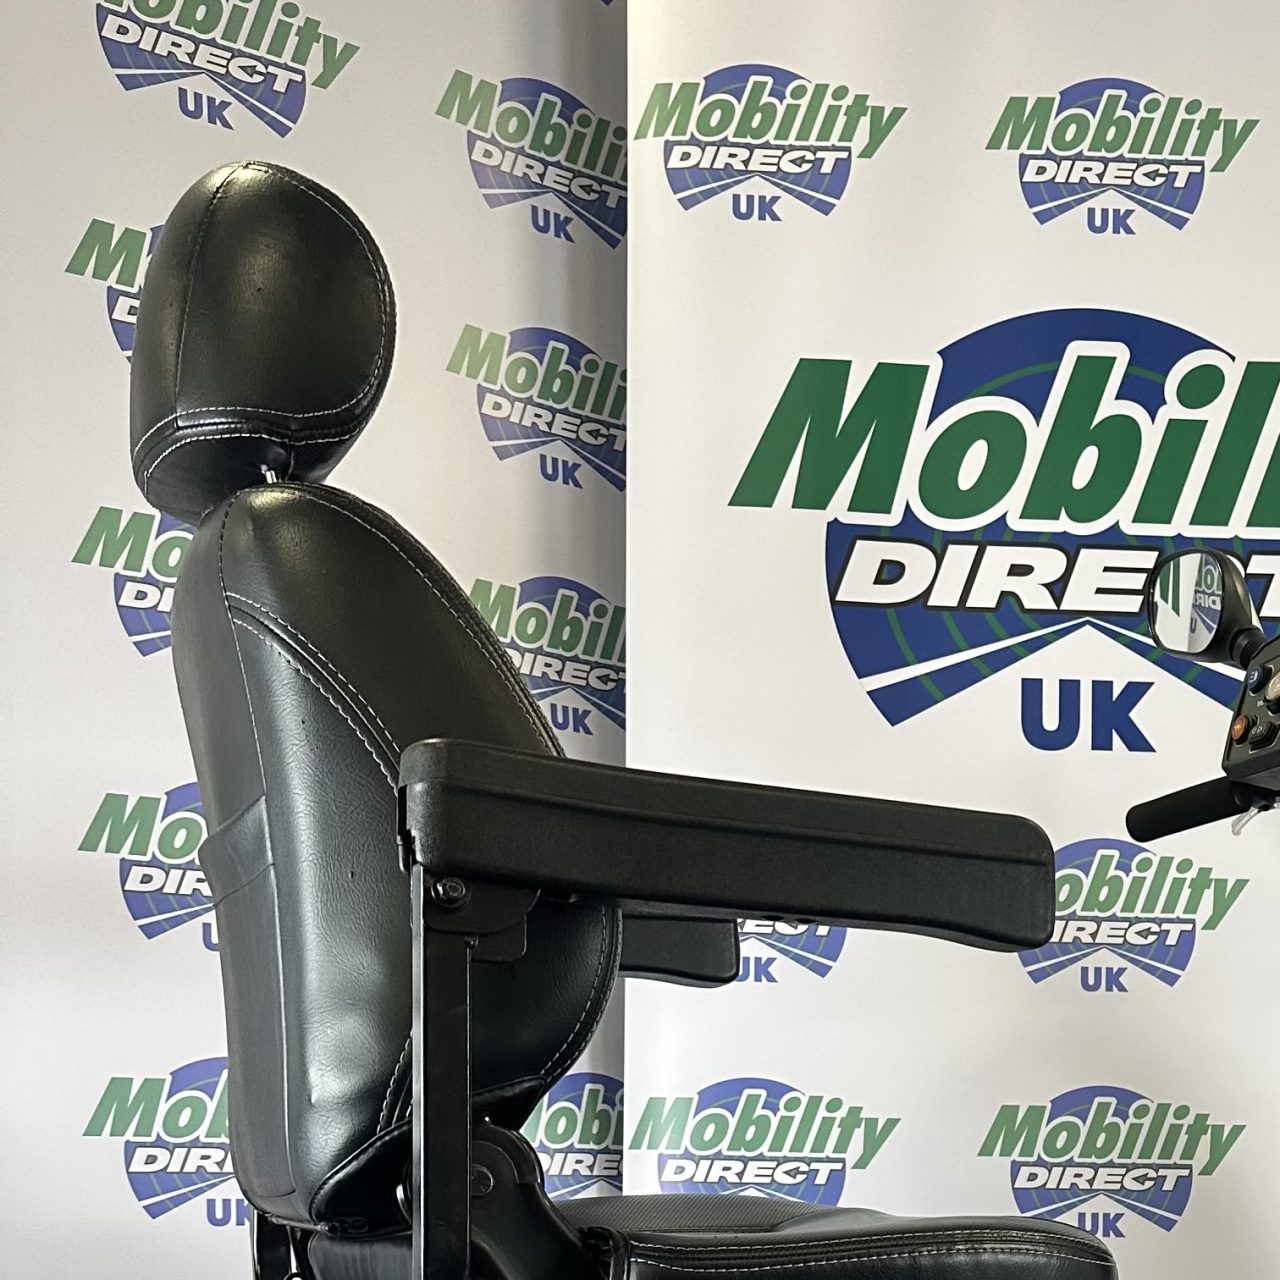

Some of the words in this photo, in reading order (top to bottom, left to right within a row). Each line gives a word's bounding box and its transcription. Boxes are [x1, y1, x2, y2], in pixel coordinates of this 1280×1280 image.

[101, 14, 303, 93] DIRECT
[103, 0, 360, 89] bility
[178, 87, 234, 131] UK
[435, 69, 627, 185] Mobili
[633, 81, 908, 159] Mobility
[985, 93, 1261, 172] Mobility
[471, 139, 627, 209] DIRECT
[667, 145, 848, 175] DIRECT
[1021, 159, 1202, 188] DIRECT
[531, 204, 575, 244] UK
[732, 194, 782, 222] UK
[1086, 207, 1136, 235] UK
[446, 324, 627, 423] Mobili
[480, 394, 627, 452] DIRECT
[539, 454, 584, 489] UK
[469, 578, 626, 664] Mobil
[505, 647, 626, 691] IREC
[551, 703, 594, 736] UK
[1019, 677, 1157, 753] UK
[124, 865, 213, 898] DIR
[1055, 854, 1250, 931] obility
[1051, 921, 1194, 946] IRECT
[1080, 966, 1129, 993] UK
[628, 1091, 902, 1170] Mobility
[977, 1101, 1248, 1176] Mobility
[128, 1147, 236, 1174] DIR
[661, 1160, 846, 1185] DIRECT
[1013, 1167, 1190, 1191] DIRECT
[1078, 1212, 1126, 1238] UK
